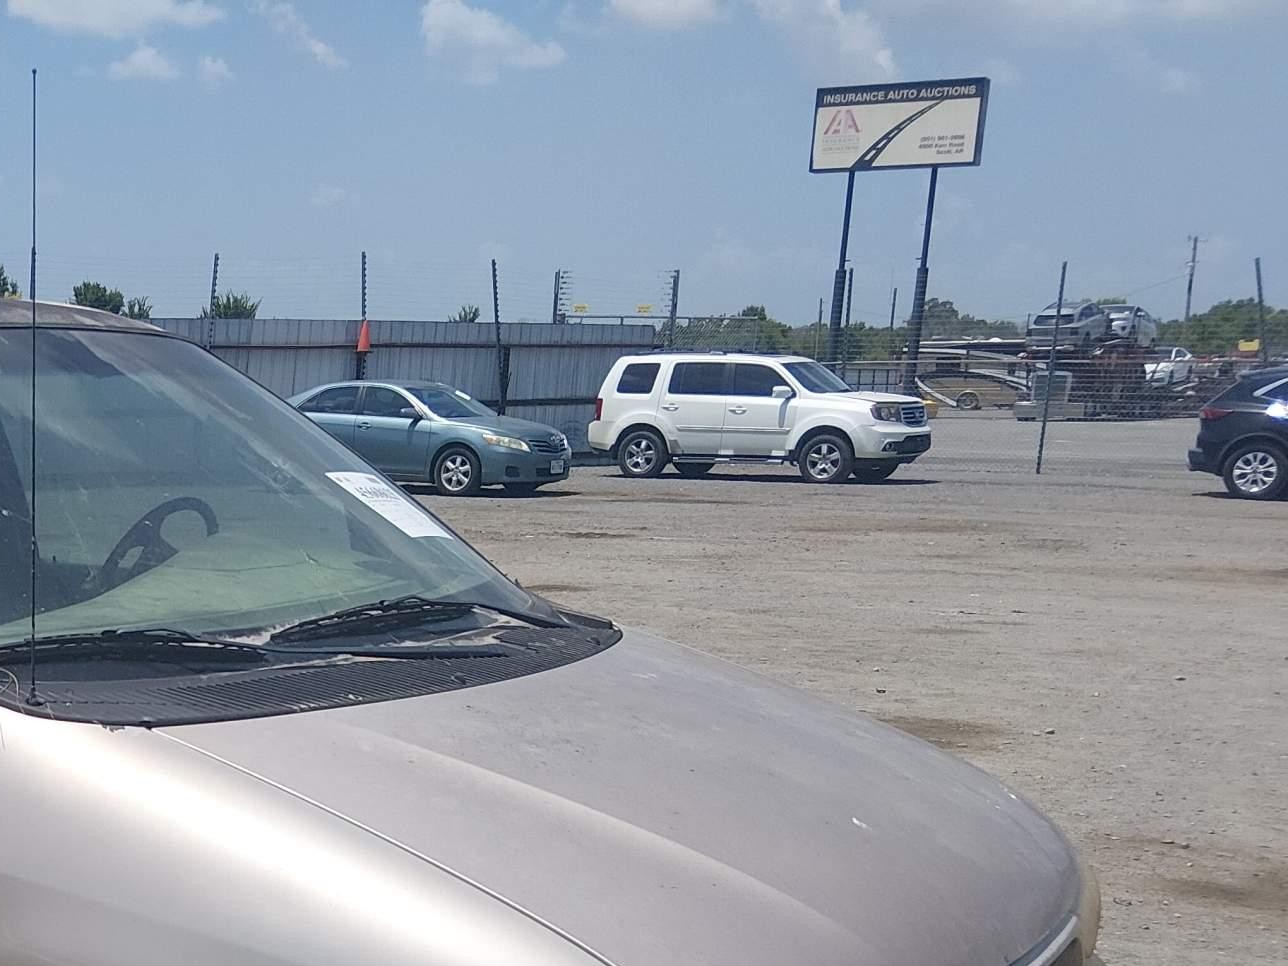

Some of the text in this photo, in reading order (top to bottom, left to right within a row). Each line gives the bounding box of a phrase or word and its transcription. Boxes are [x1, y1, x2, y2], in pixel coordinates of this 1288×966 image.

[823, 85, 976, 104] INSURANCE AUTO AUCTIONS
